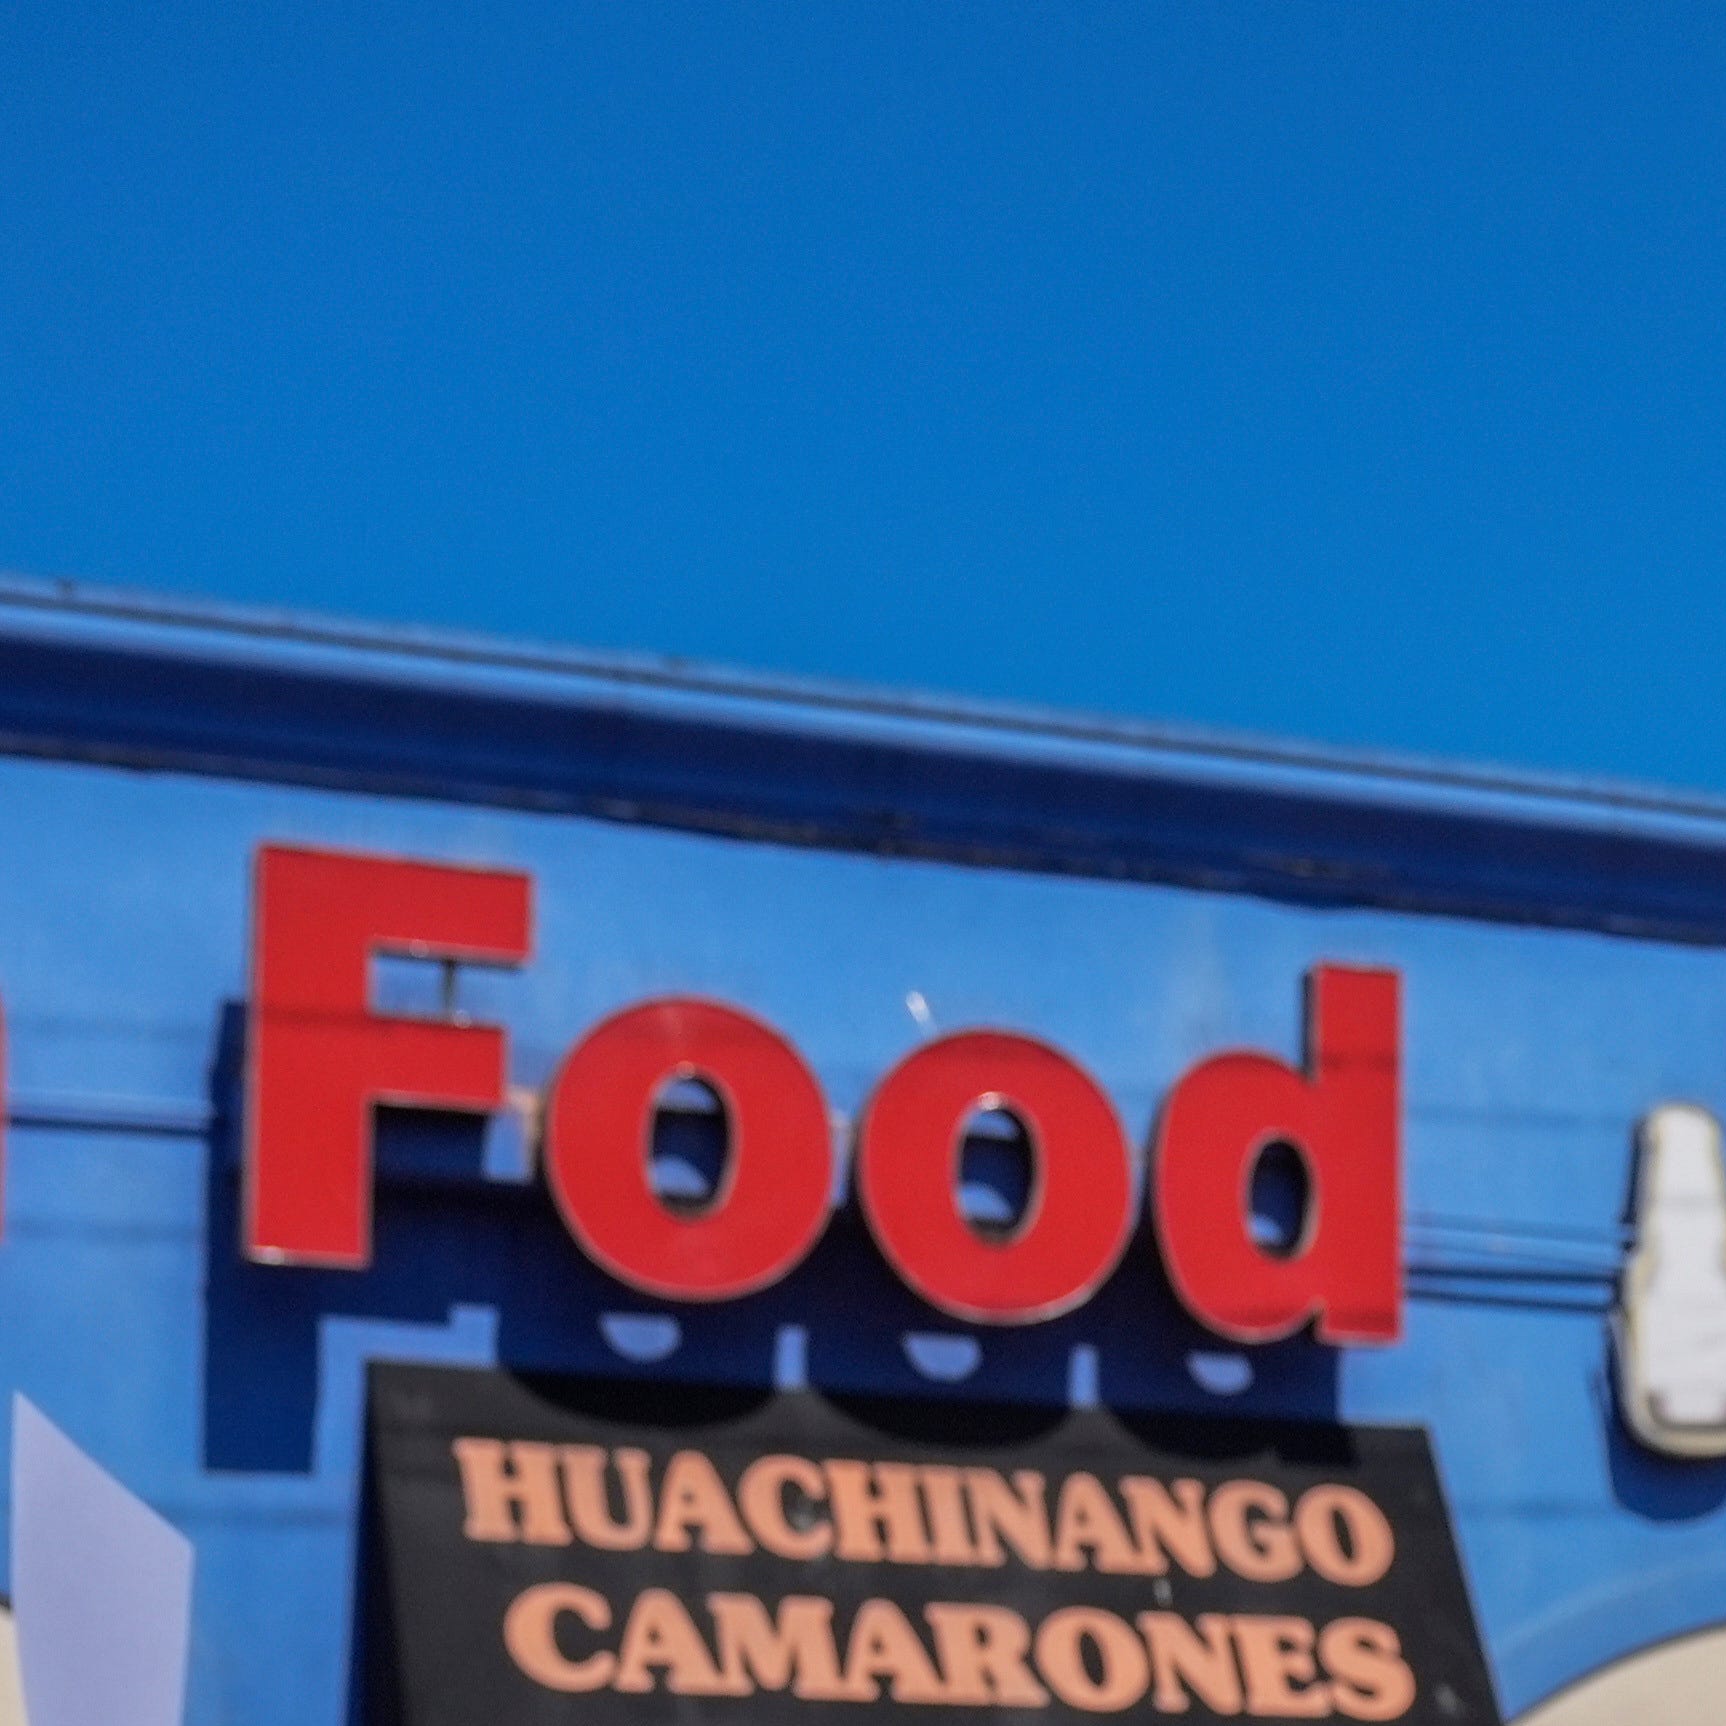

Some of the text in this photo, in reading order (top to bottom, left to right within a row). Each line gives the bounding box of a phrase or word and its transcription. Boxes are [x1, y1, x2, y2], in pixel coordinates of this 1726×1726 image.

[243, 841, 1403, 1345] Food
[453, 1437, 1394, 1588] HUACHINANGO
[503, 1581, 1417, 1722] CAMARONES
